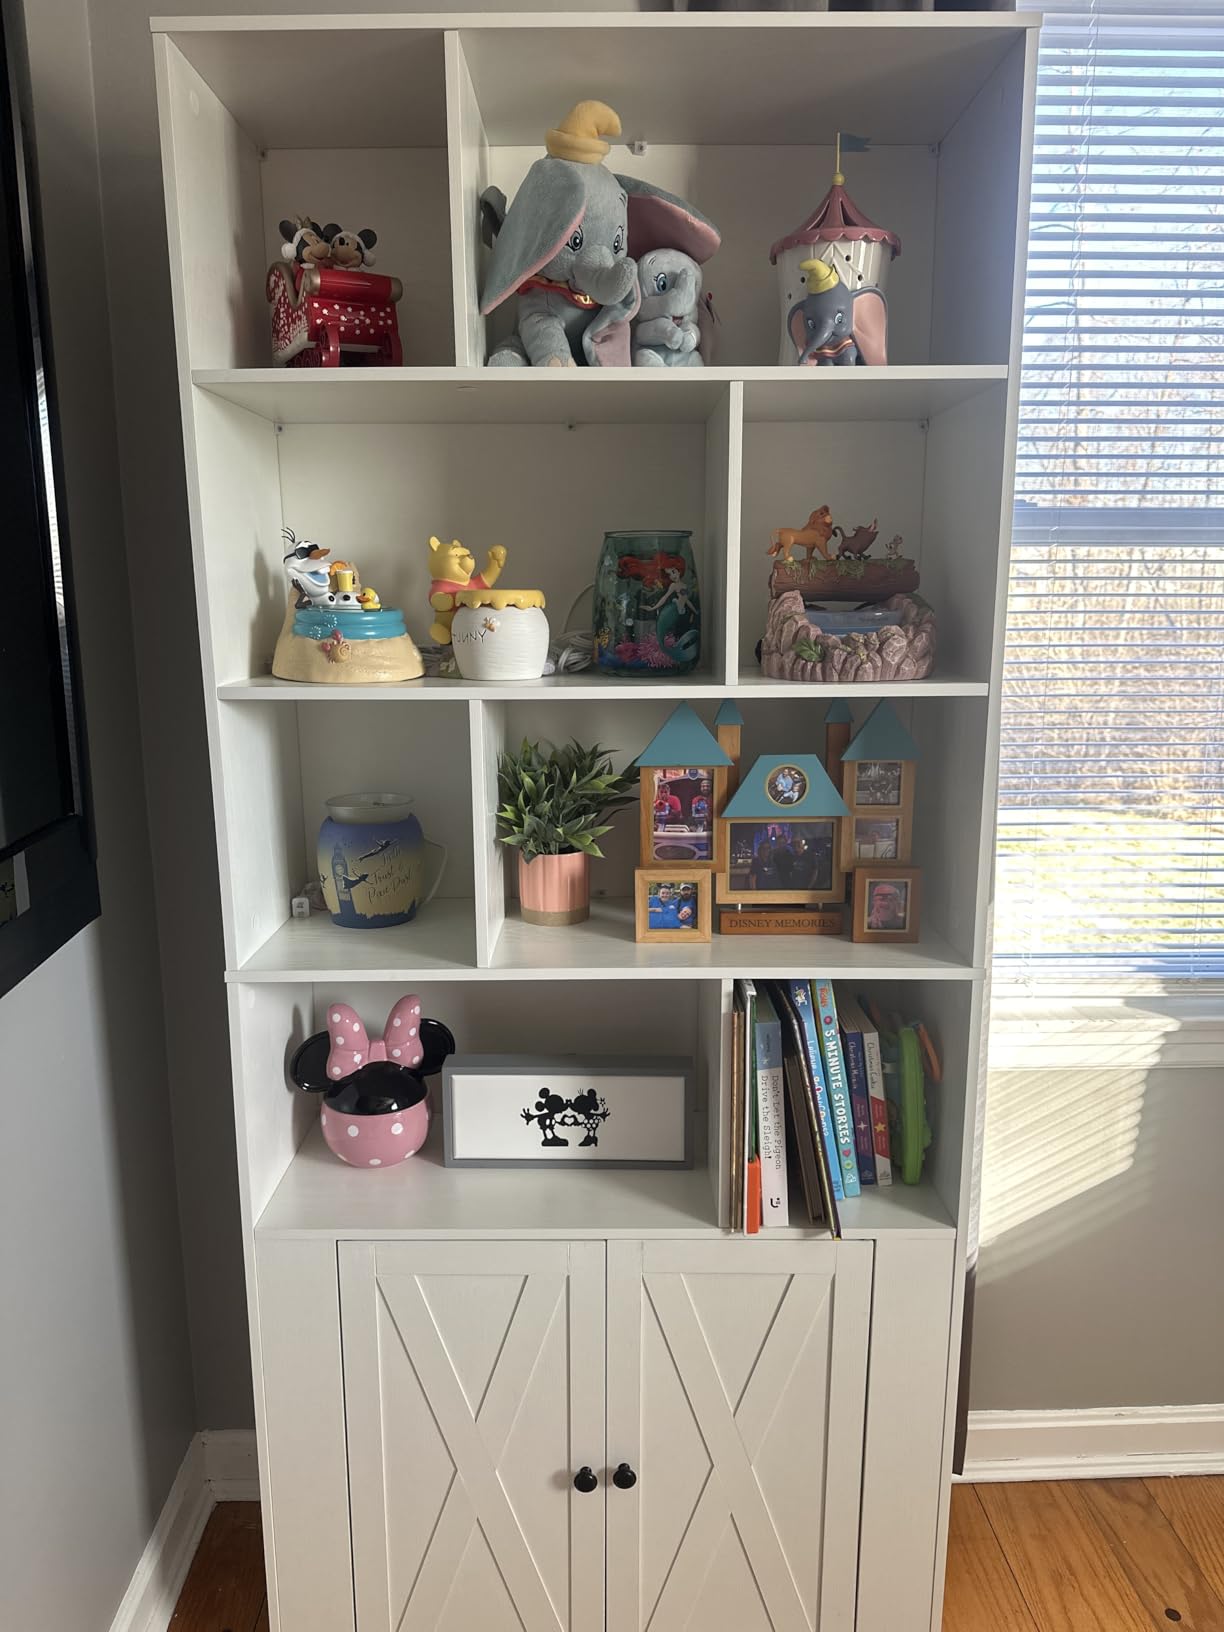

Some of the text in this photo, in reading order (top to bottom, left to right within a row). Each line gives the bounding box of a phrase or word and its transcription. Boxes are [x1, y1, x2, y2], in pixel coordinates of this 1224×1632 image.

[728, 918, 835, 929] DISNEY MEMORIES
[772, 1075, 781, 1099] Don't
[824, 1029, 851, 1145] 5-MINUTE STORIES
[761, 1075, 772, 1160] Drive the Sleigh!
[774, 1121, 782, 1136] the
[773, 1139, 783, 1170] Pigeon
